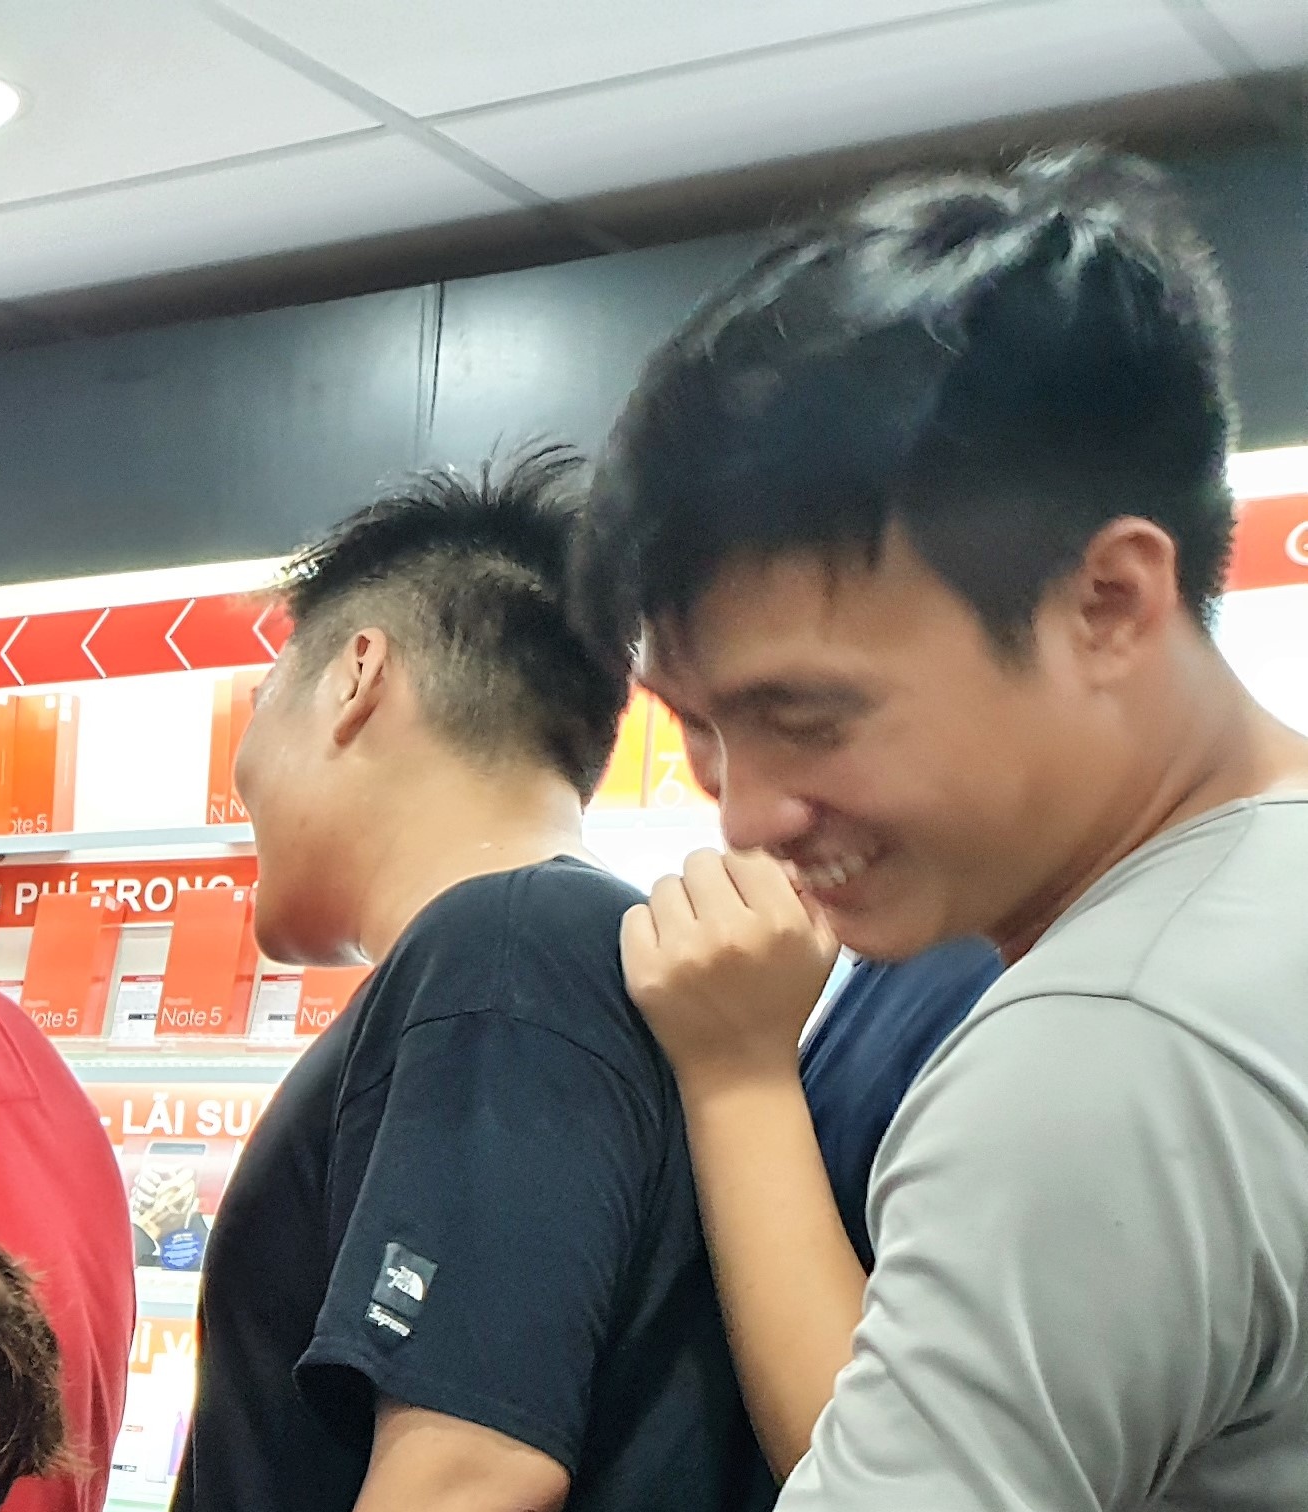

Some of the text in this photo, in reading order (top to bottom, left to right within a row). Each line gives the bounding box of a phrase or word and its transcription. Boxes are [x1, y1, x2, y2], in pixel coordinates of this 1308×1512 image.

[160, 1005, 223, 1028] Note 5
[122, 1092, 184, 1136] LÃI
